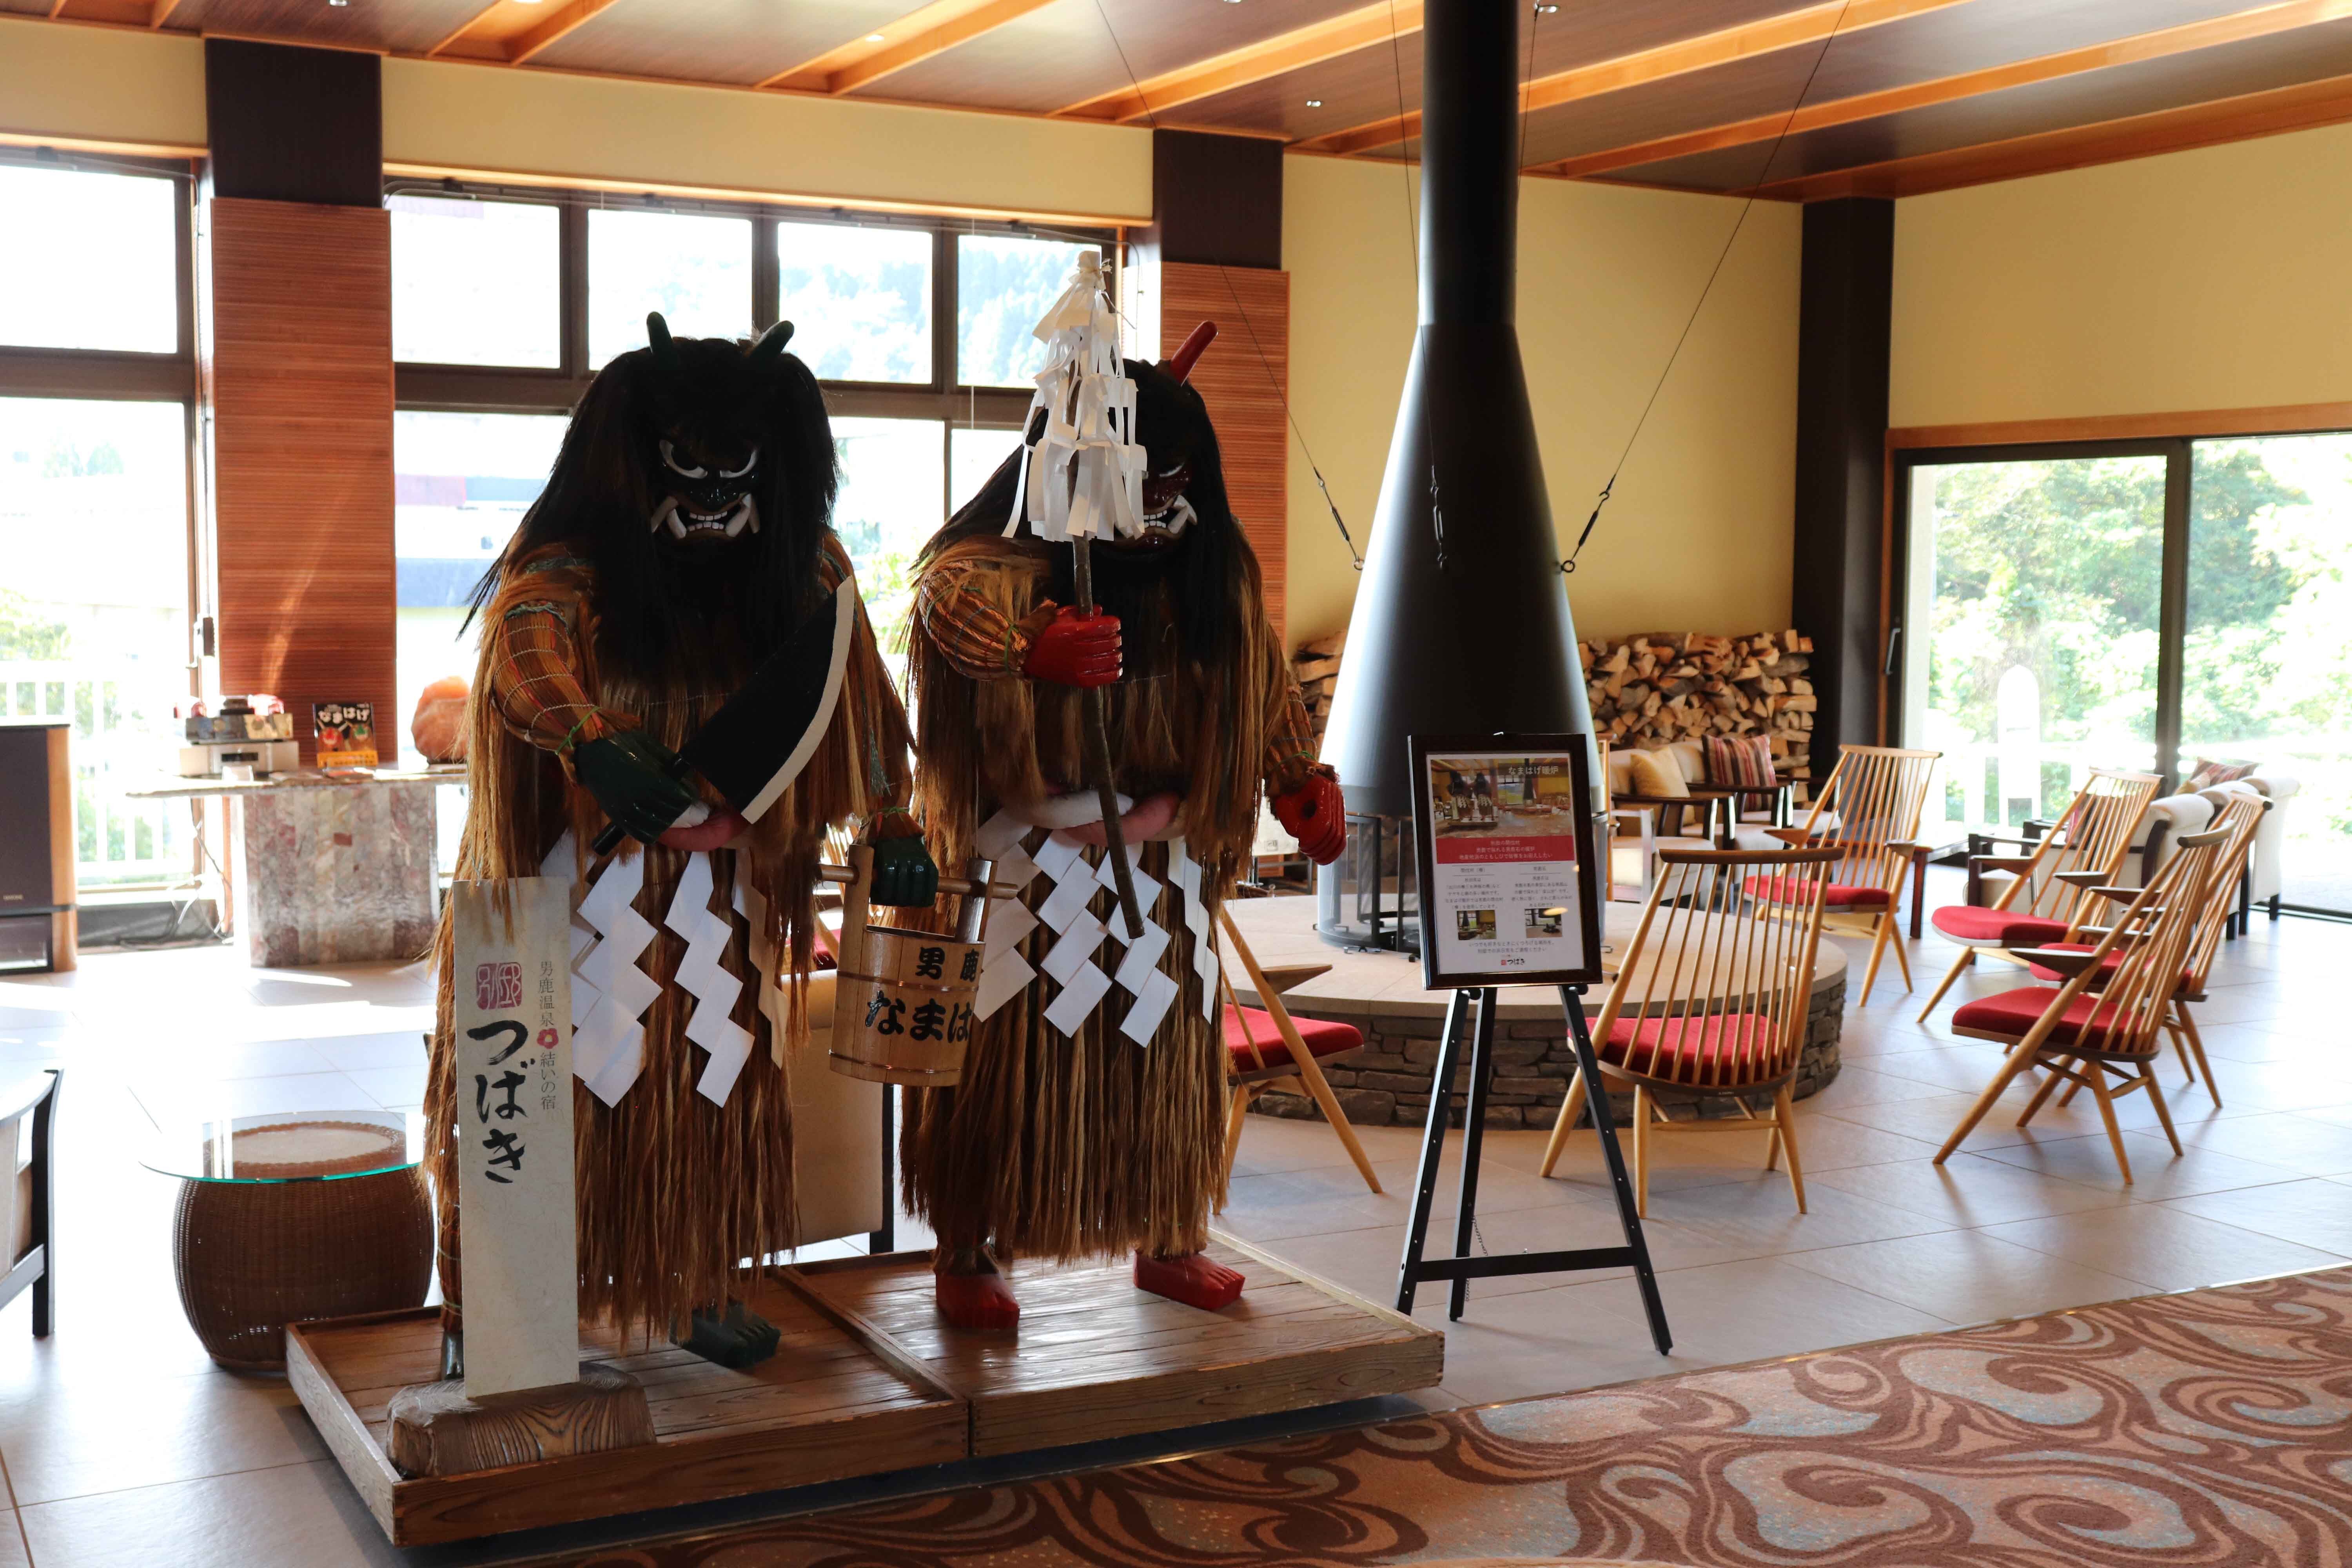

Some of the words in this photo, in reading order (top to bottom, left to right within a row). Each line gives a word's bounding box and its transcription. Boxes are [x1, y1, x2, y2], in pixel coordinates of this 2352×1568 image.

[1508, 766, 1559, 775] なまはげ暖炉
[915, 947, 980, 982] 男鹿
[539, 961, 555, 1027] 男鹿温泉
[466, 1020, 535, 1183] つばき
[540, 1052, 556, 1110] 結いの宿
